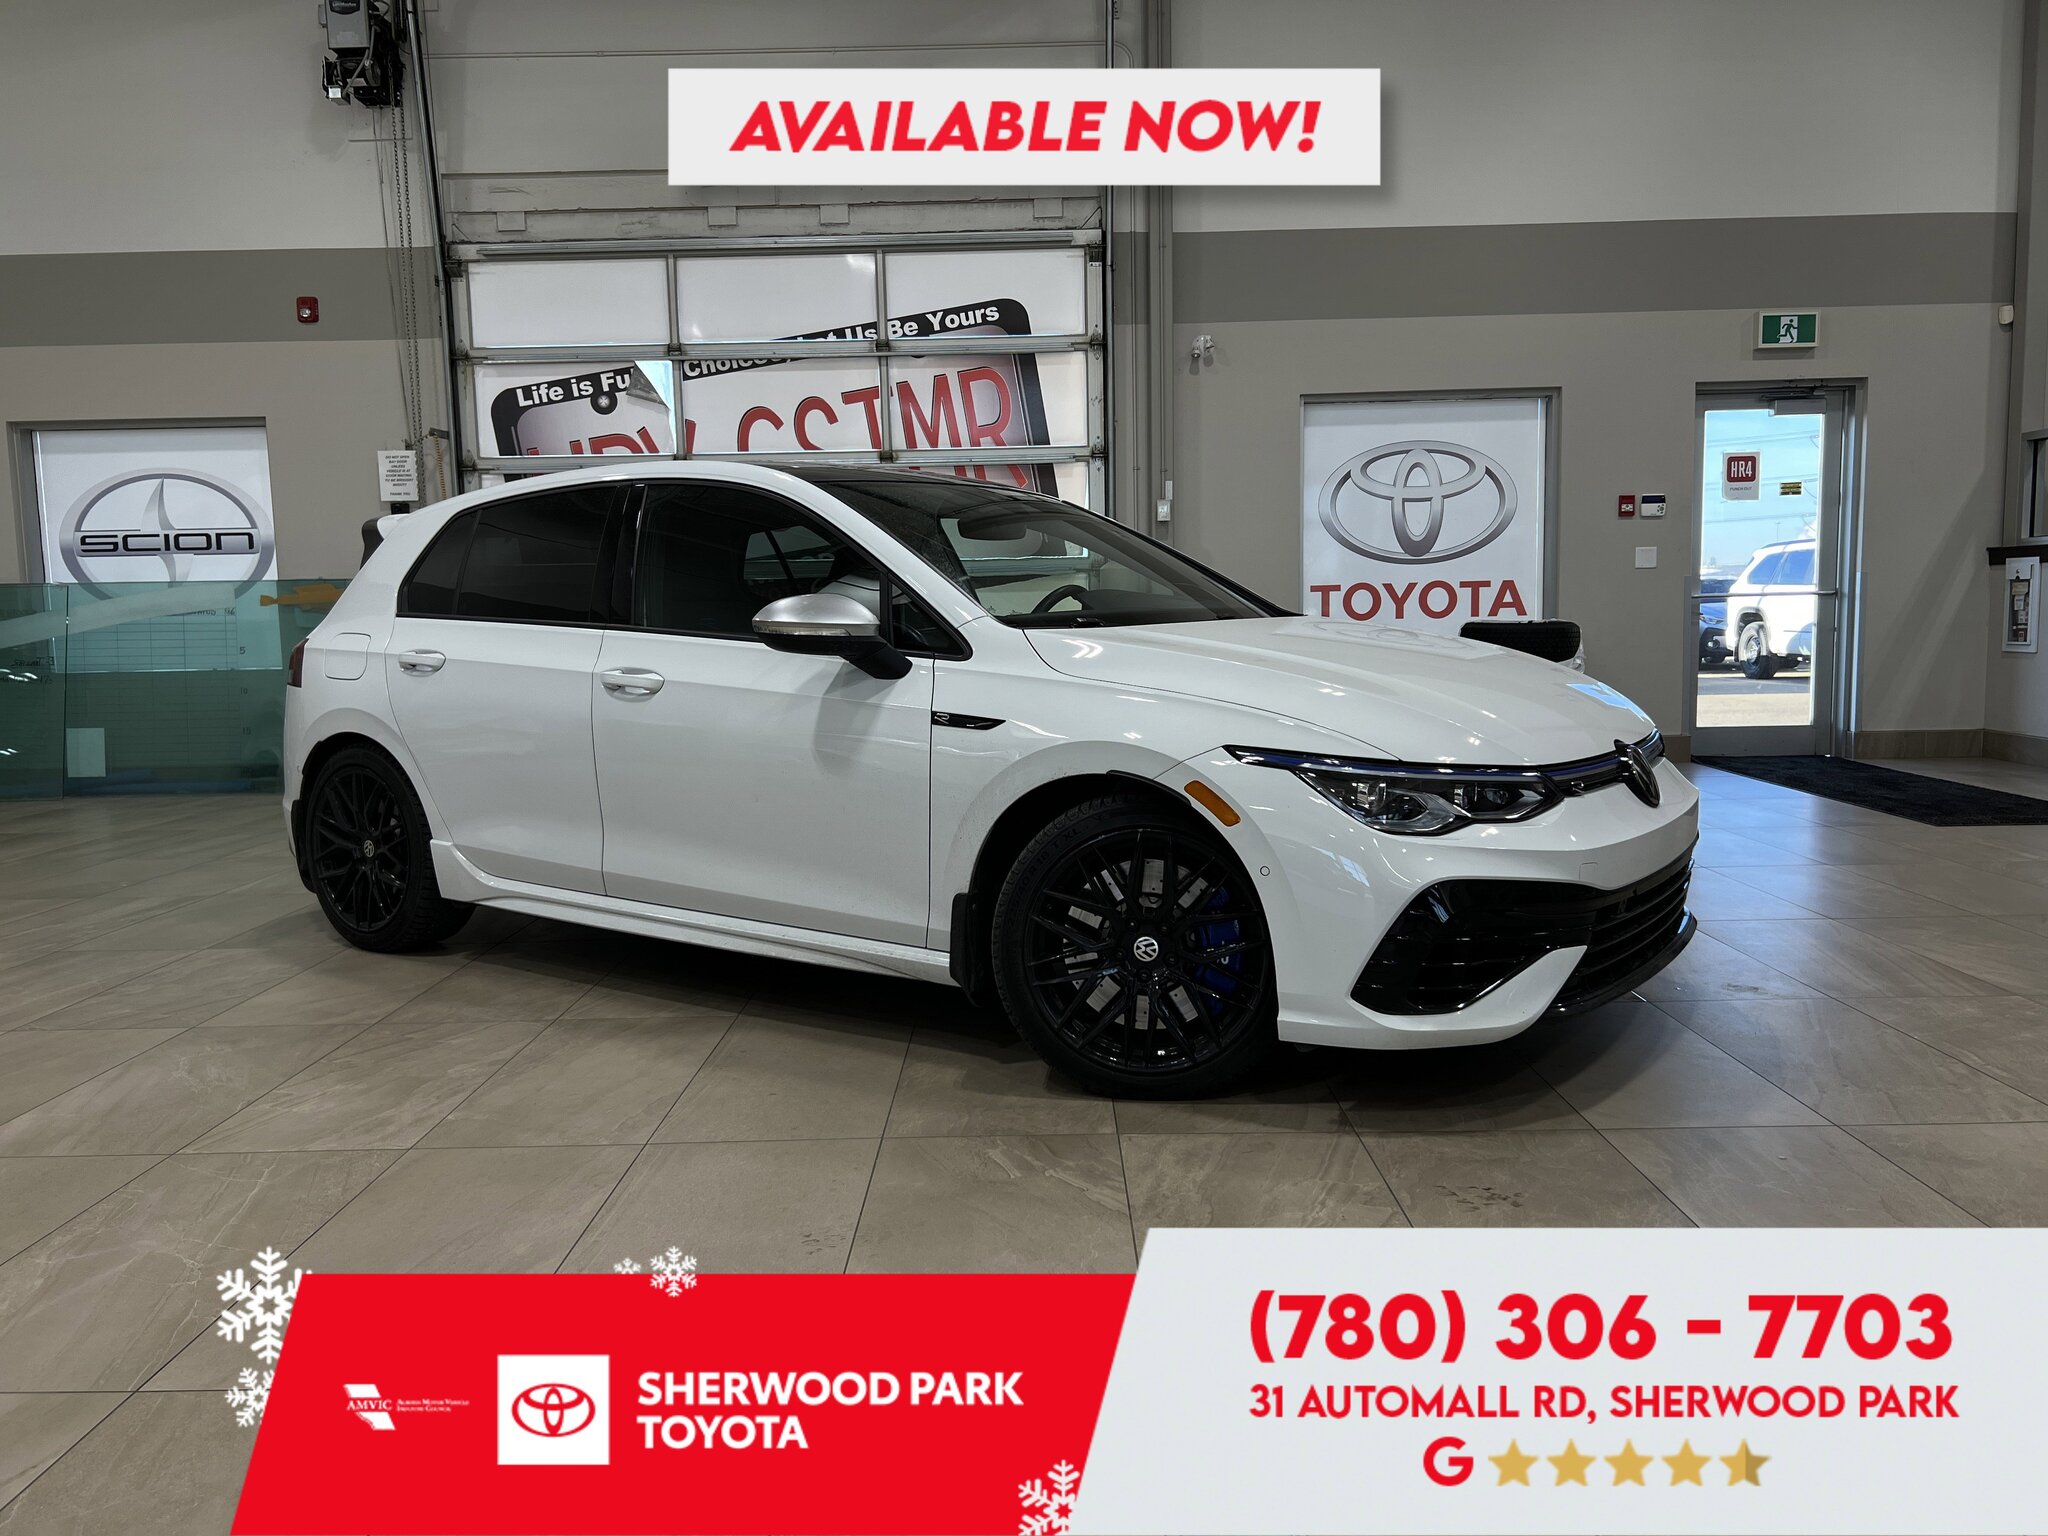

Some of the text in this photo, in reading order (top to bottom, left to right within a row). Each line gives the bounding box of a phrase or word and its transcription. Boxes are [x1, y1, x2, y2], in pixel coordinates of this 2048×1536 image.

[516, 384, 564, 407] Life
[571, 379, 594, 397] is
[600, 368, 635, 392] Fu
[887, 319, 919, 338] Be
[925, 306, 1000, 331] Yours
[1730, 461, 1752, 477] HR4
[80, 532, 254, 553] SCION
[1310, 579, 1528, 622] TOYOTA
